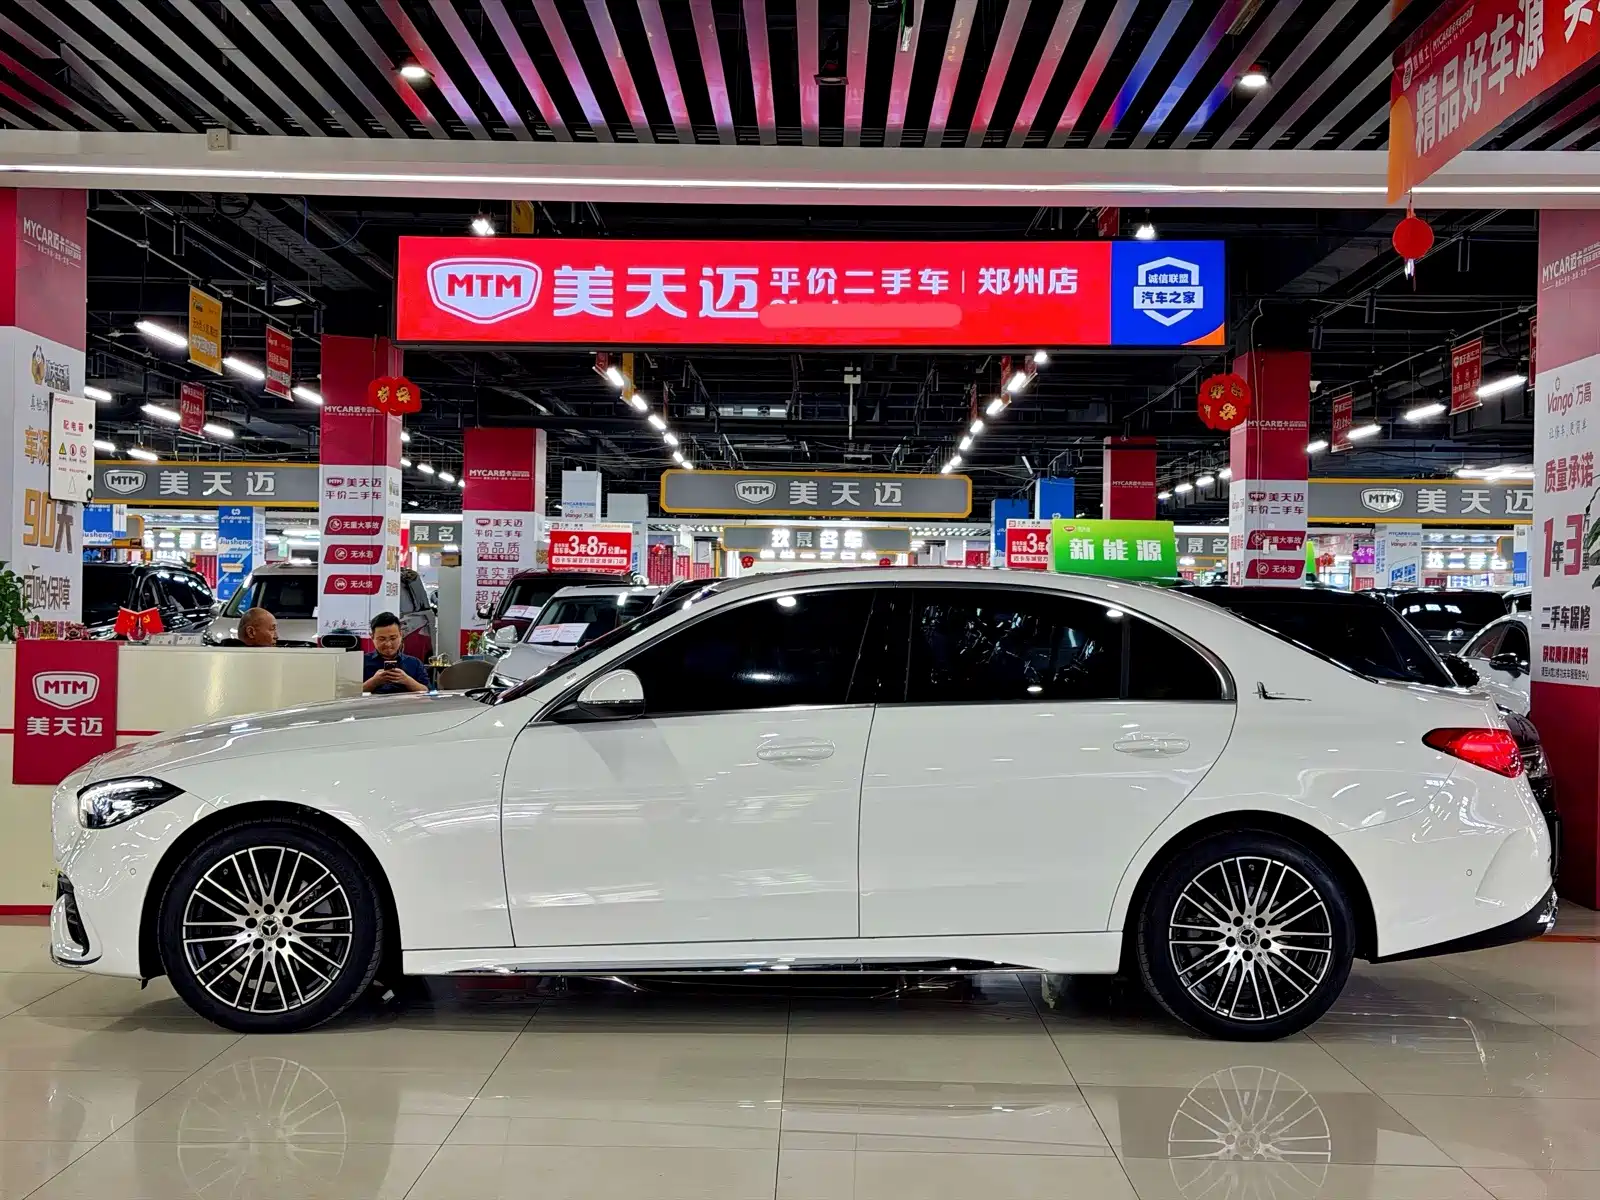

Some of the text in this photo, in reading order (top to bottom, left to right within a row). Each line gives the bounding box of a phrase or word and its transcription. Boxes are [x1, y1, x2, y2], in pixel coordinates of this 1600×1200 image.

[1415, 0, 1544, 158] 精品好车源
[447, 273, 522, 298] MTM
[769, 267, 1079, 295] 平价二手车 郑州店
[1147, 273, 1190, 285] 诚信联盟
[553, 265, 760, 319] 美天迈
[1141, 290, 1196, 304] 汽车之家
[63, 419, 84, 432] 配电箱
[1544, 452, 1594, 494] 质量承诺
[110, 470, 276, 497] MTM 美天迈
[347, 477, 382, 488] 美天迈
[325, 490, 382, 500] 平价二手车
[742, 481, 903, 507] MTM 美天迈
[1268, 492, 1305, 502] 美天迈
[1368, 488, 1533, 514] MTM 美天迈
[1247, 505, 1305, 515] 平价二手车
[23, 488, 73, 553] 90天
[342, 521, 380, 529] 无重大事故
[493, 518, 523, 527] 美天迈
[475, 529, 523, 538] 平价二手车
[476, 541, 520, 554] 高品质
[1069, 537, 1162, 561] 新能源
[1271, 564, 1296, 574] 无水泡
[1541, 605, 1591, 632] 二手车保修
[43, 680, 88, 695] MTM
[26, 716, 104, 737] 美天迈
